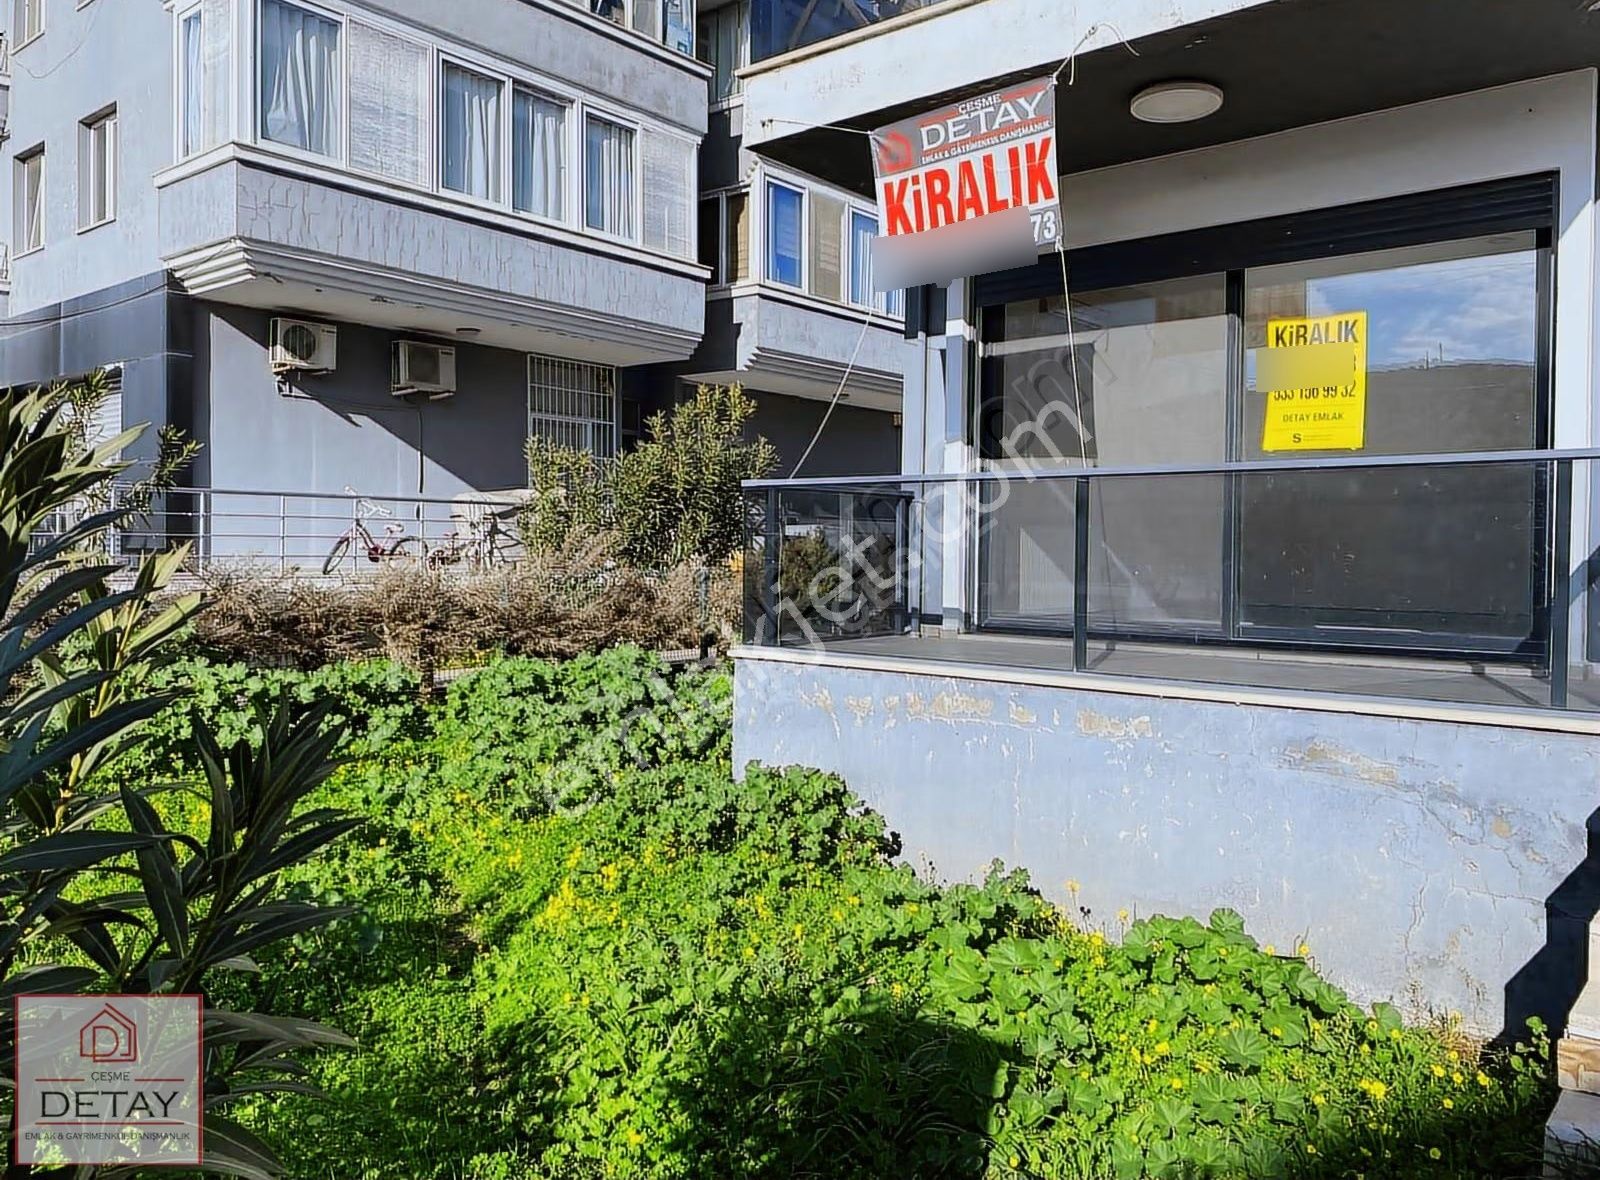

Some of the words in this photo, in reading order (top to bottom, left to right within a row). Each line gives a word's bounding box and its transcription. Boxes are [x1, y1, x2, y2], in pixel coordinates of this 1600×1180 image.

[920, 90, 1046, 151] DETAY
[1282, 413, 1310, 423] DETAY
[1313, 412, 1344, 422] EMLAK
